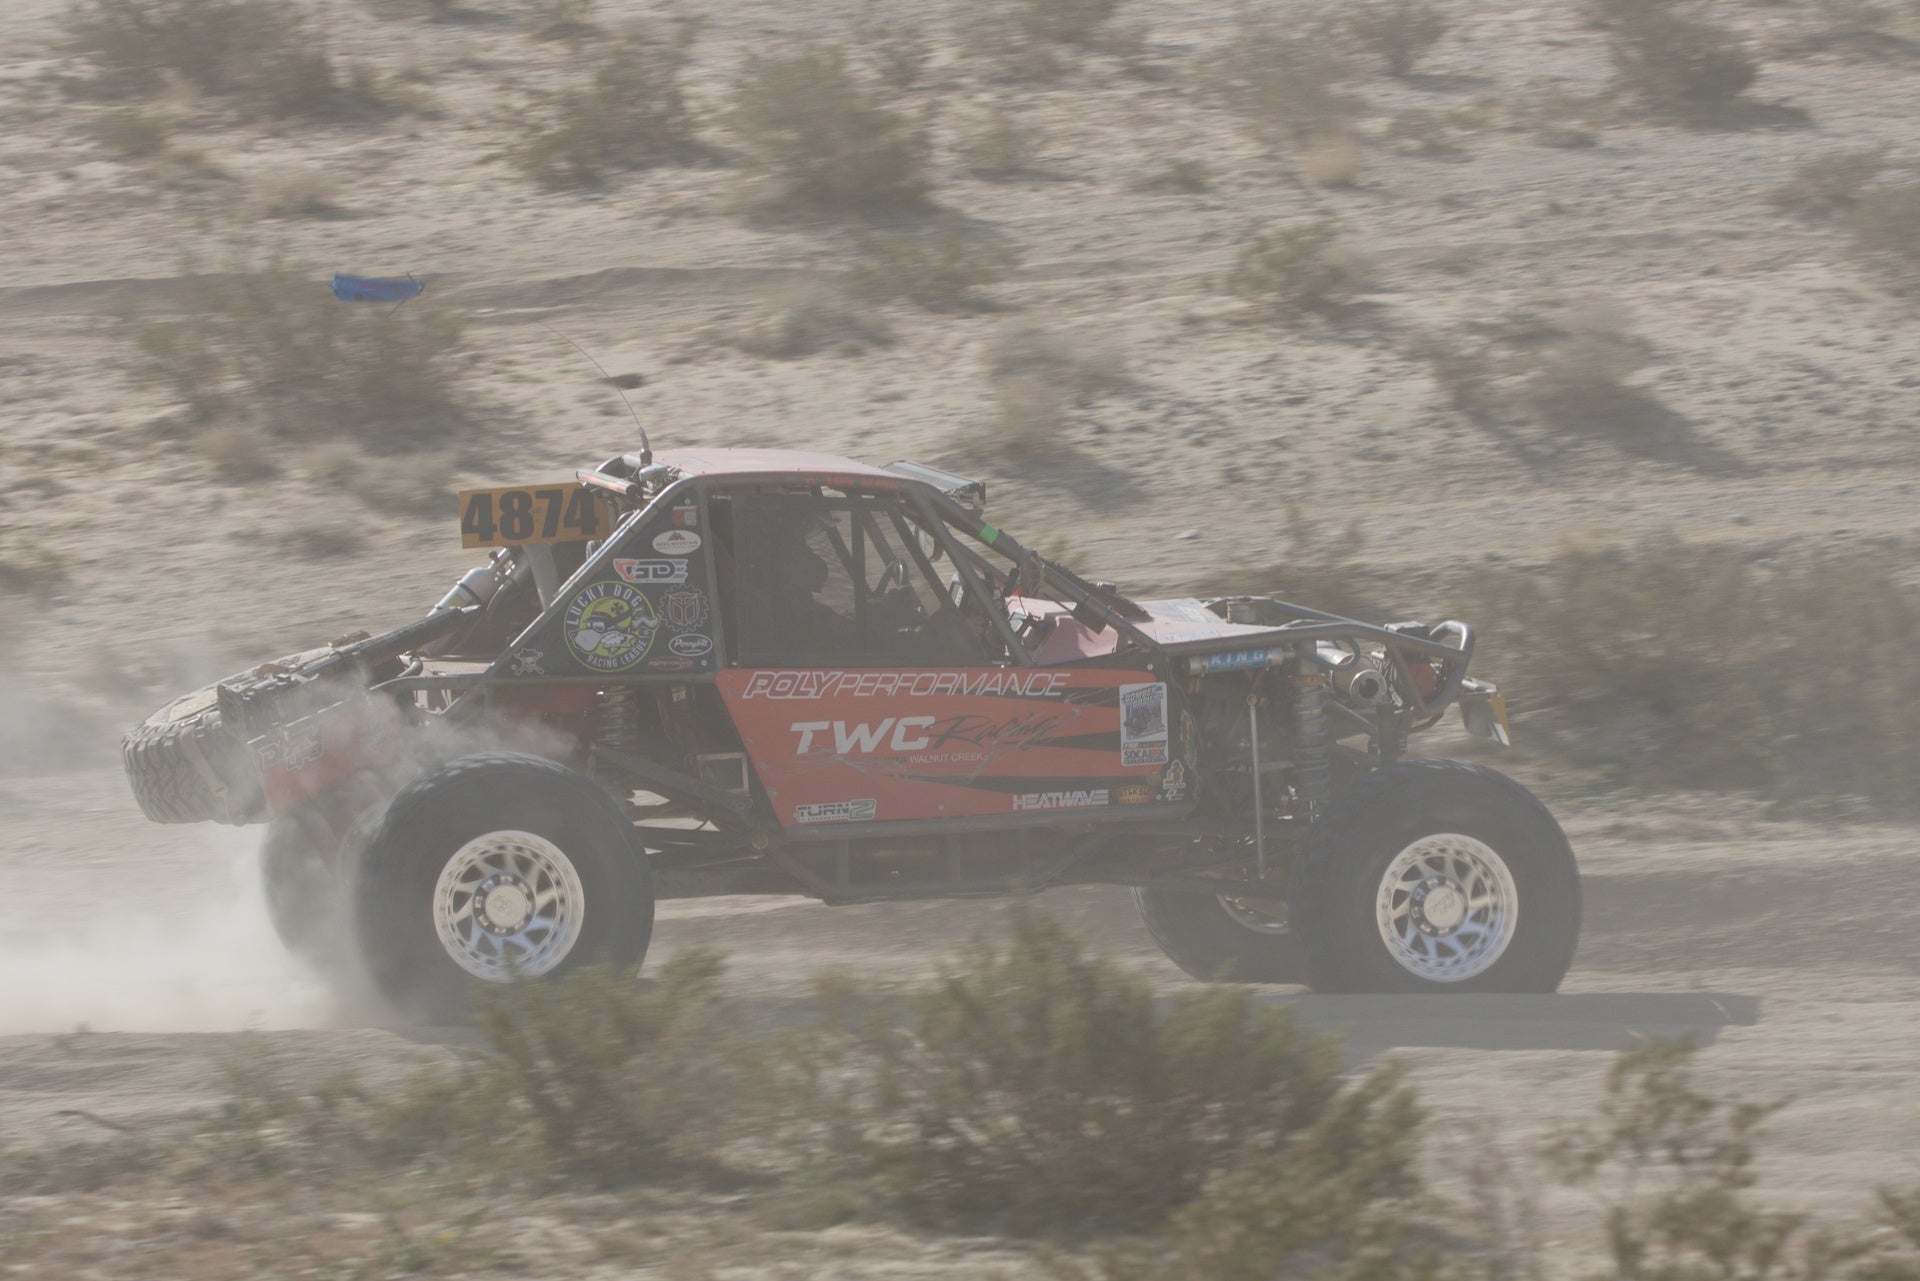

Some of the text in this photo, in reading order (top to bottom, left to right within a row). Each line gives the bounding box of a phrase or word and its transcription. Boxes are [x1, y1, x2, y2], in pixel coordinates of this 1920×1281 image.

[462, 487, 599, 541] 4874
[567, 584, 642, 625] LUCKY DOG
[587, 639, 648, 668] RACING LEAGUE
[1211, 650, 1264, 665] KING
[791, 715, 935, 755] TWC
[909, 752, 949, 764] WALNUT
[951, 751, 986, 762] CREEK
[1013, 789, 1109, 811] HEATWAVE
